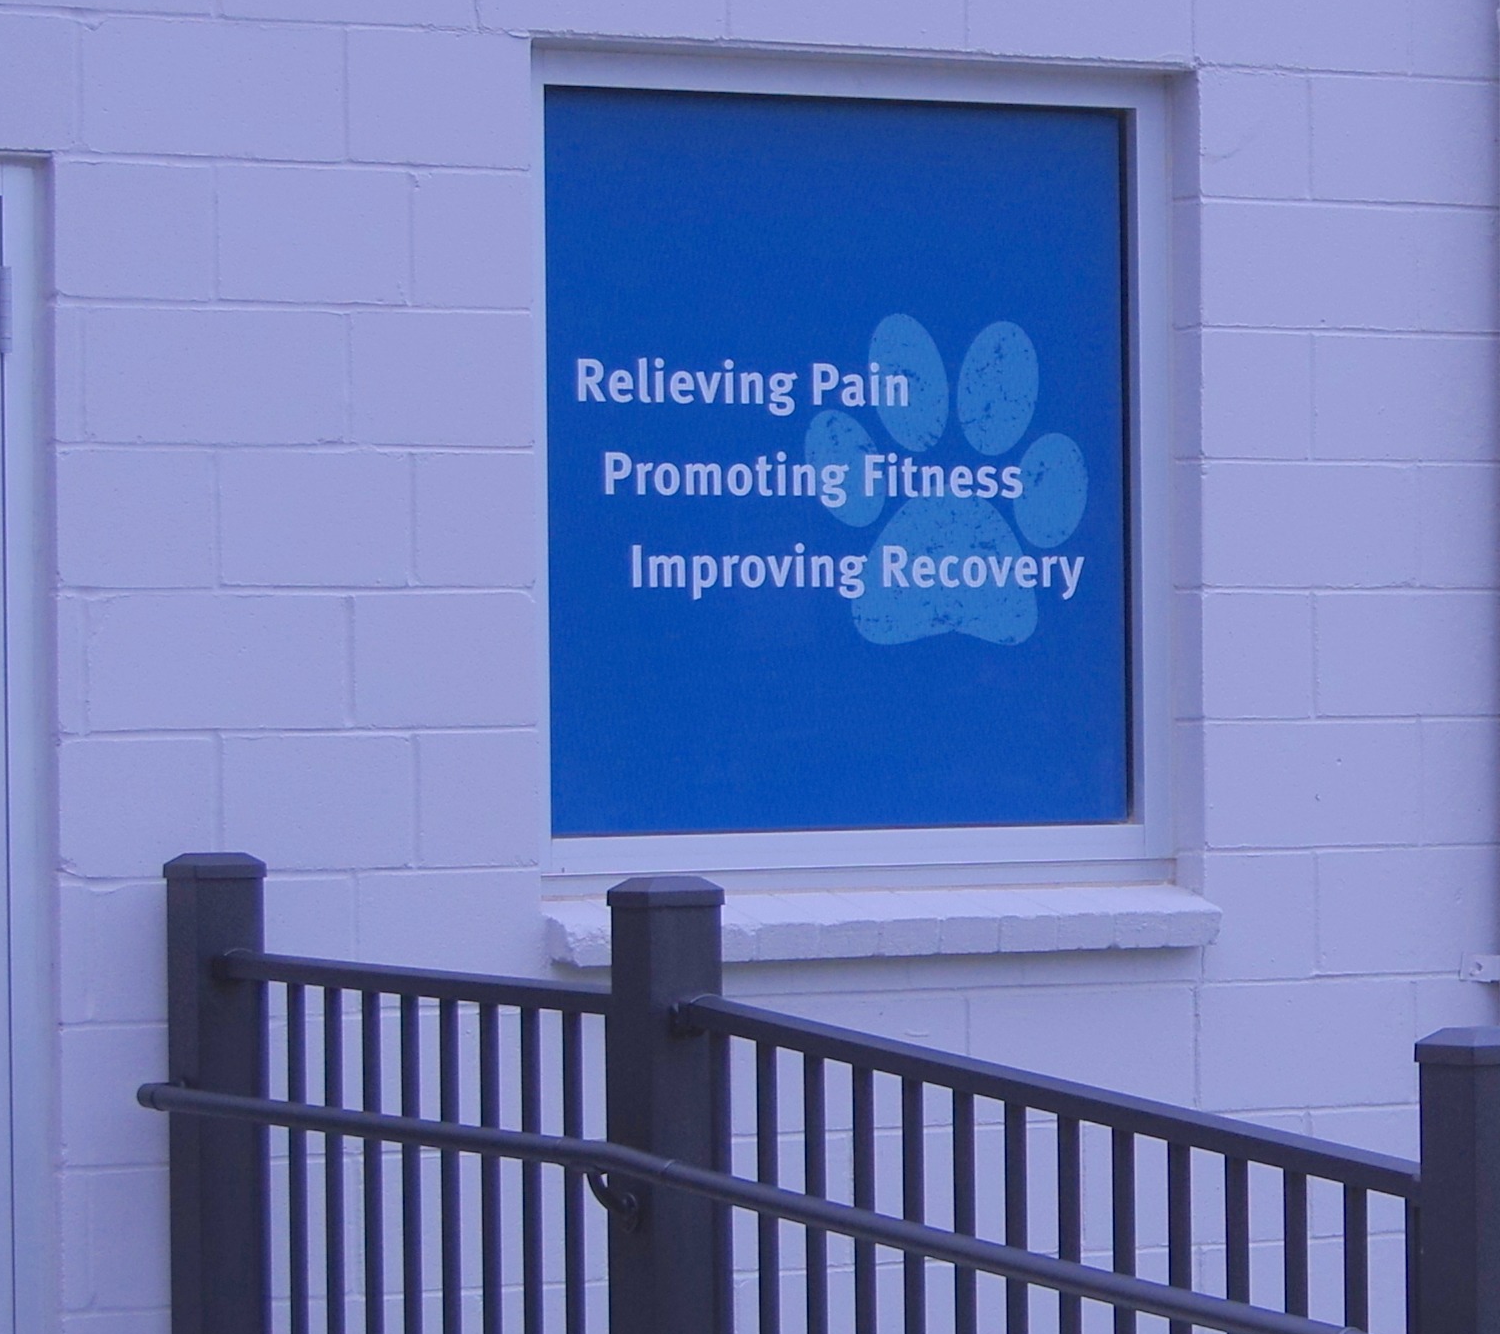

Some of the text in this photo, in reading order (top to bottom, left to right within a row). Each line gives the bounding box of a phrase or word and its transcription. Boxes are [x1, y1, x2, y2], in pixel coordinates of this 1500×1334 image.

[577, 358, 910, 416] Relieving Pain
[604, 452, 1024, 508] Promoting Fitness
[631, 544, 1085, 600] Improving Recovery
